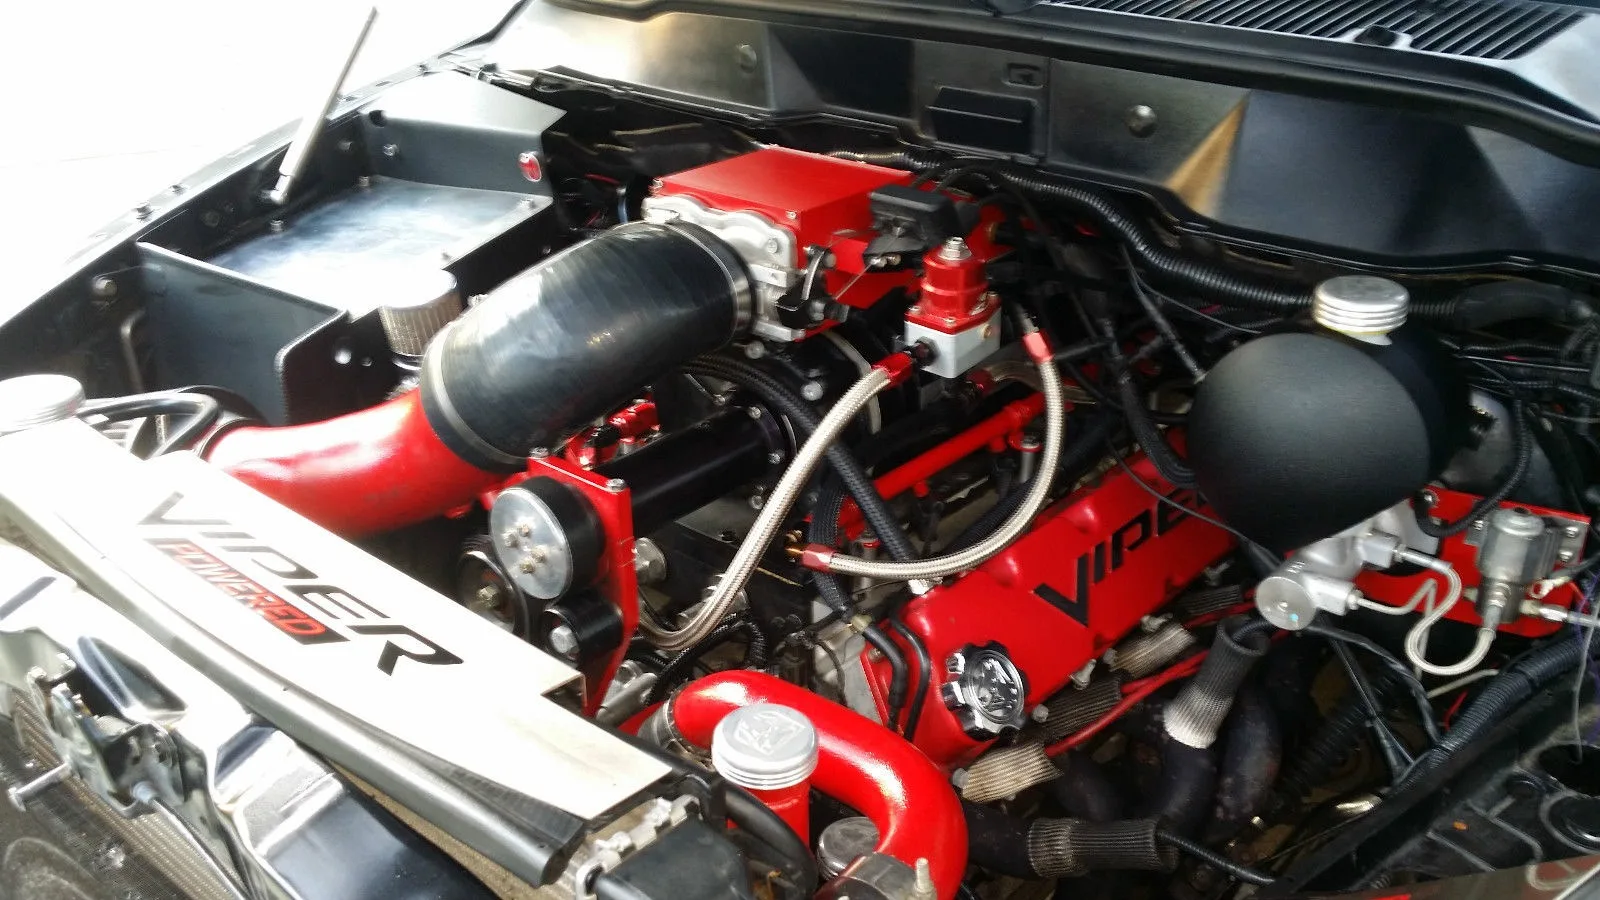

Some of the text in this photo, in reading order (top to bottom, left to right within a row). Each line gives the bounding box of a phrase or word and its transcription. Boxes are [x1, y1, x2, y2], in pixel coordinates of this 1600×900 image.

[138, 491, 464, 676] VIPER
[152, 541, 328, 636] POWERED
[1033, 487, 1207, 628] VIPE
